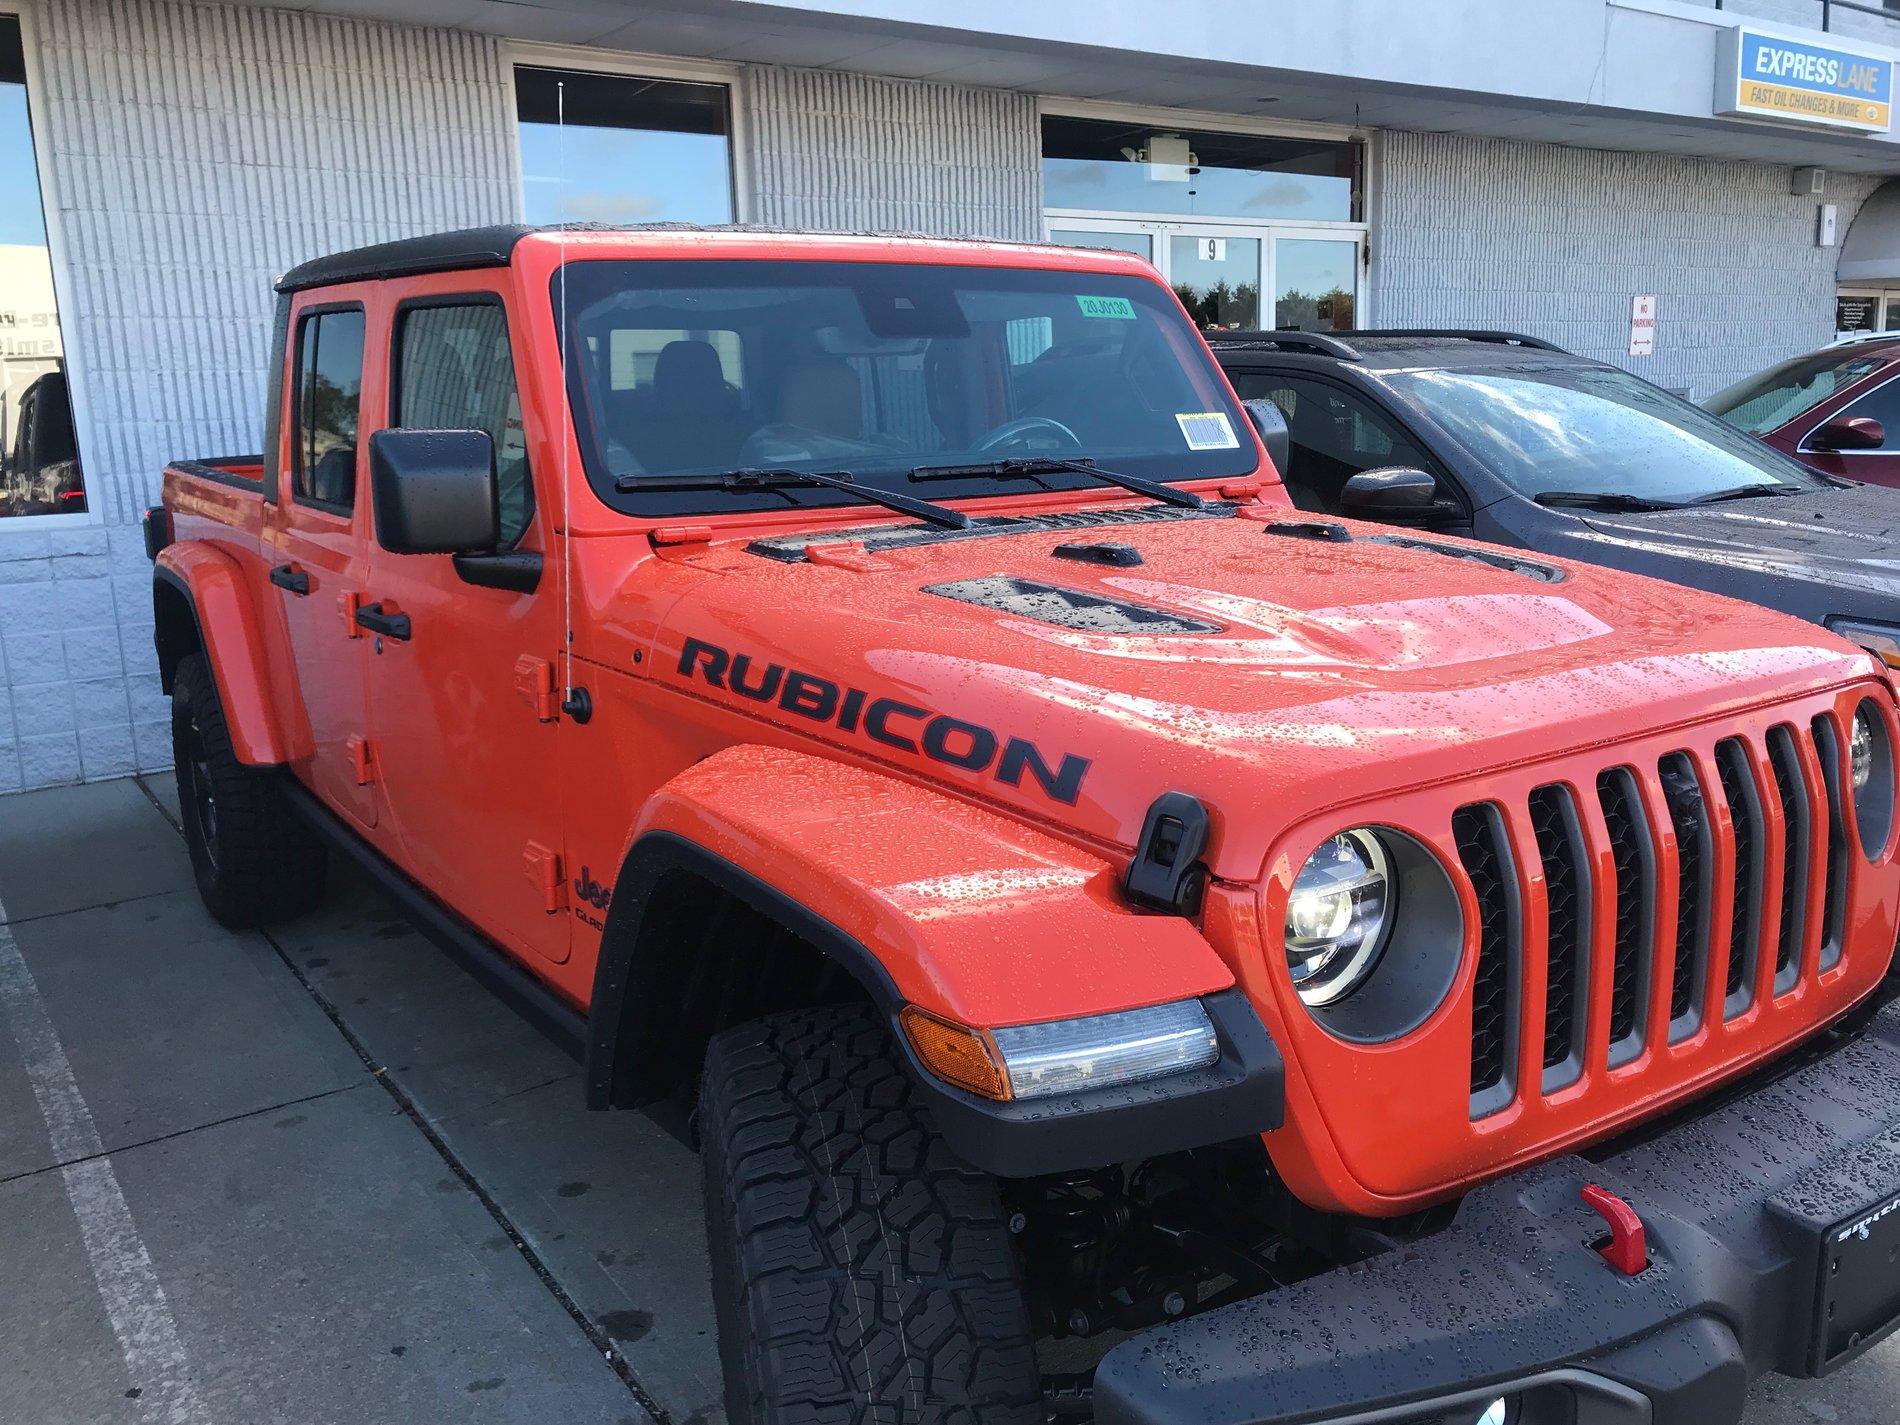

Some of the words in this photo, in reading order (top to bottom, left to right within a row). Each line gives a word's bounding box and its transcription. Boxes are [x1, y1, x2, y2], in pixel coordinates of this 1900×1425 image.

[1751, 87, 1773, 105] FAST
[1774, 91, 1787, 107] OIL
[1789, 93, 1829, 113] CHANGES
[1829, 101, 1836, 114] &
[1837, 101, 1860, 118] MORE
[1208, 239, 1216, 260] 9
[1640, 304, 1648, 313] NO
[1633, 319, 1654, 328] PARKING
[676, 636, 1092, 807] RUBICON
